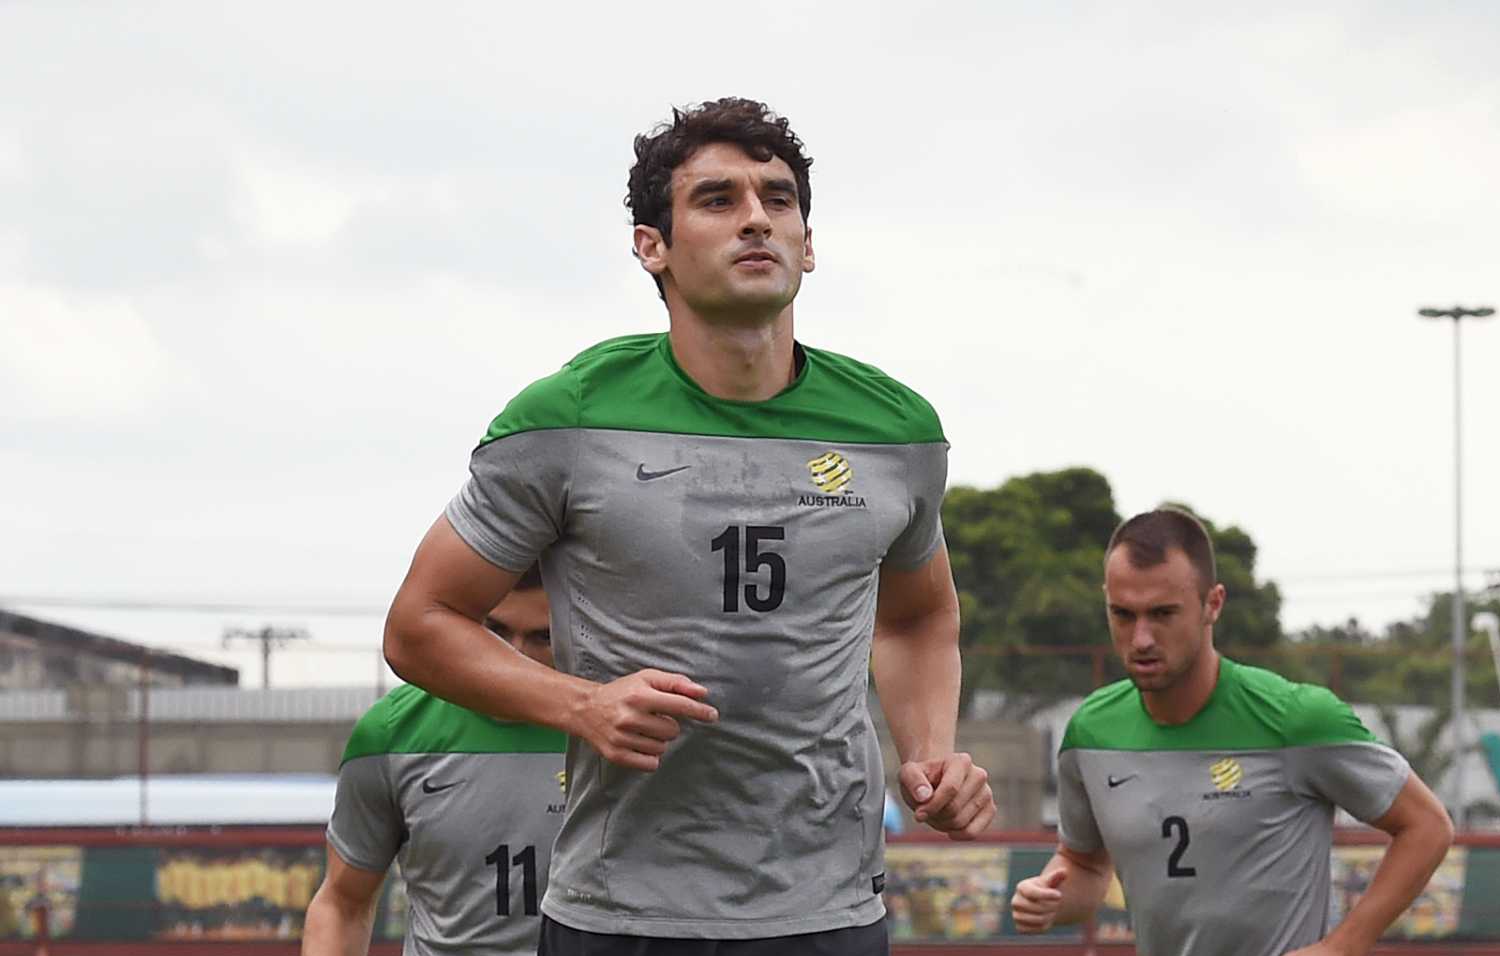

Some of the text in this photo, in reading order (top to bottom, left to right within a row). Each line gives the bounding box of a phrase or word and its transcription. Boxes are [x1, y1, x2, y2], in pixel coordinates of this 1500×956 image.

[798, 496, 866, 508] AUSTRALIA
[711, 526, 786, 612] 15
[485, 844, 538, 916] 11
[1162, 816, 1196, 878] 2
